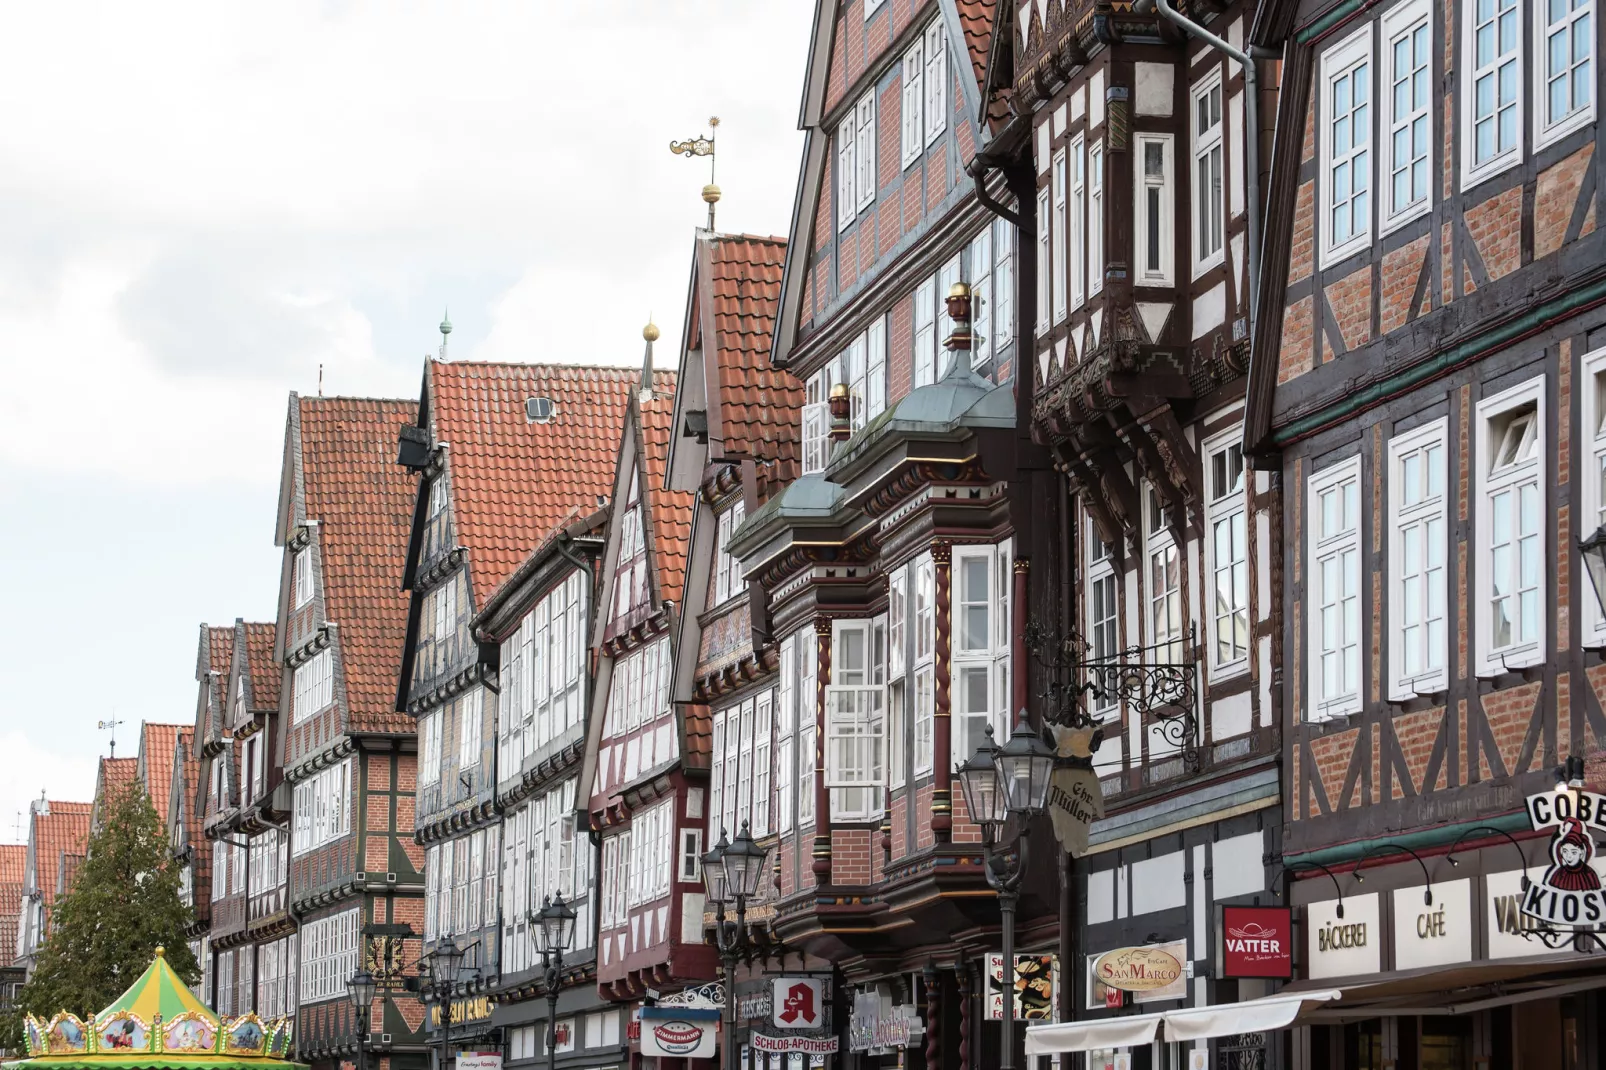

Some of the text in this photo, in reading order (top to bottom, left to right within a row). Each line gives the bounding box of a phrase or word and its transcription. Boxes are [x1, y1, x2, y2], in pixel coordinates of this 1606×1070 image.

[1049, 785, 1091, 824] Müller
[1416, 903, 1446, 939] CAFÉ
[1318, 921, 1367, 952] BÄCKEREI
[1225, 939, 1280, 953] VATTER
[991, 957, 1018, 967] Sui
[656, 1028, 700, 1041] ZIMMERMANN
[480, 1060, 498, 1068] family
